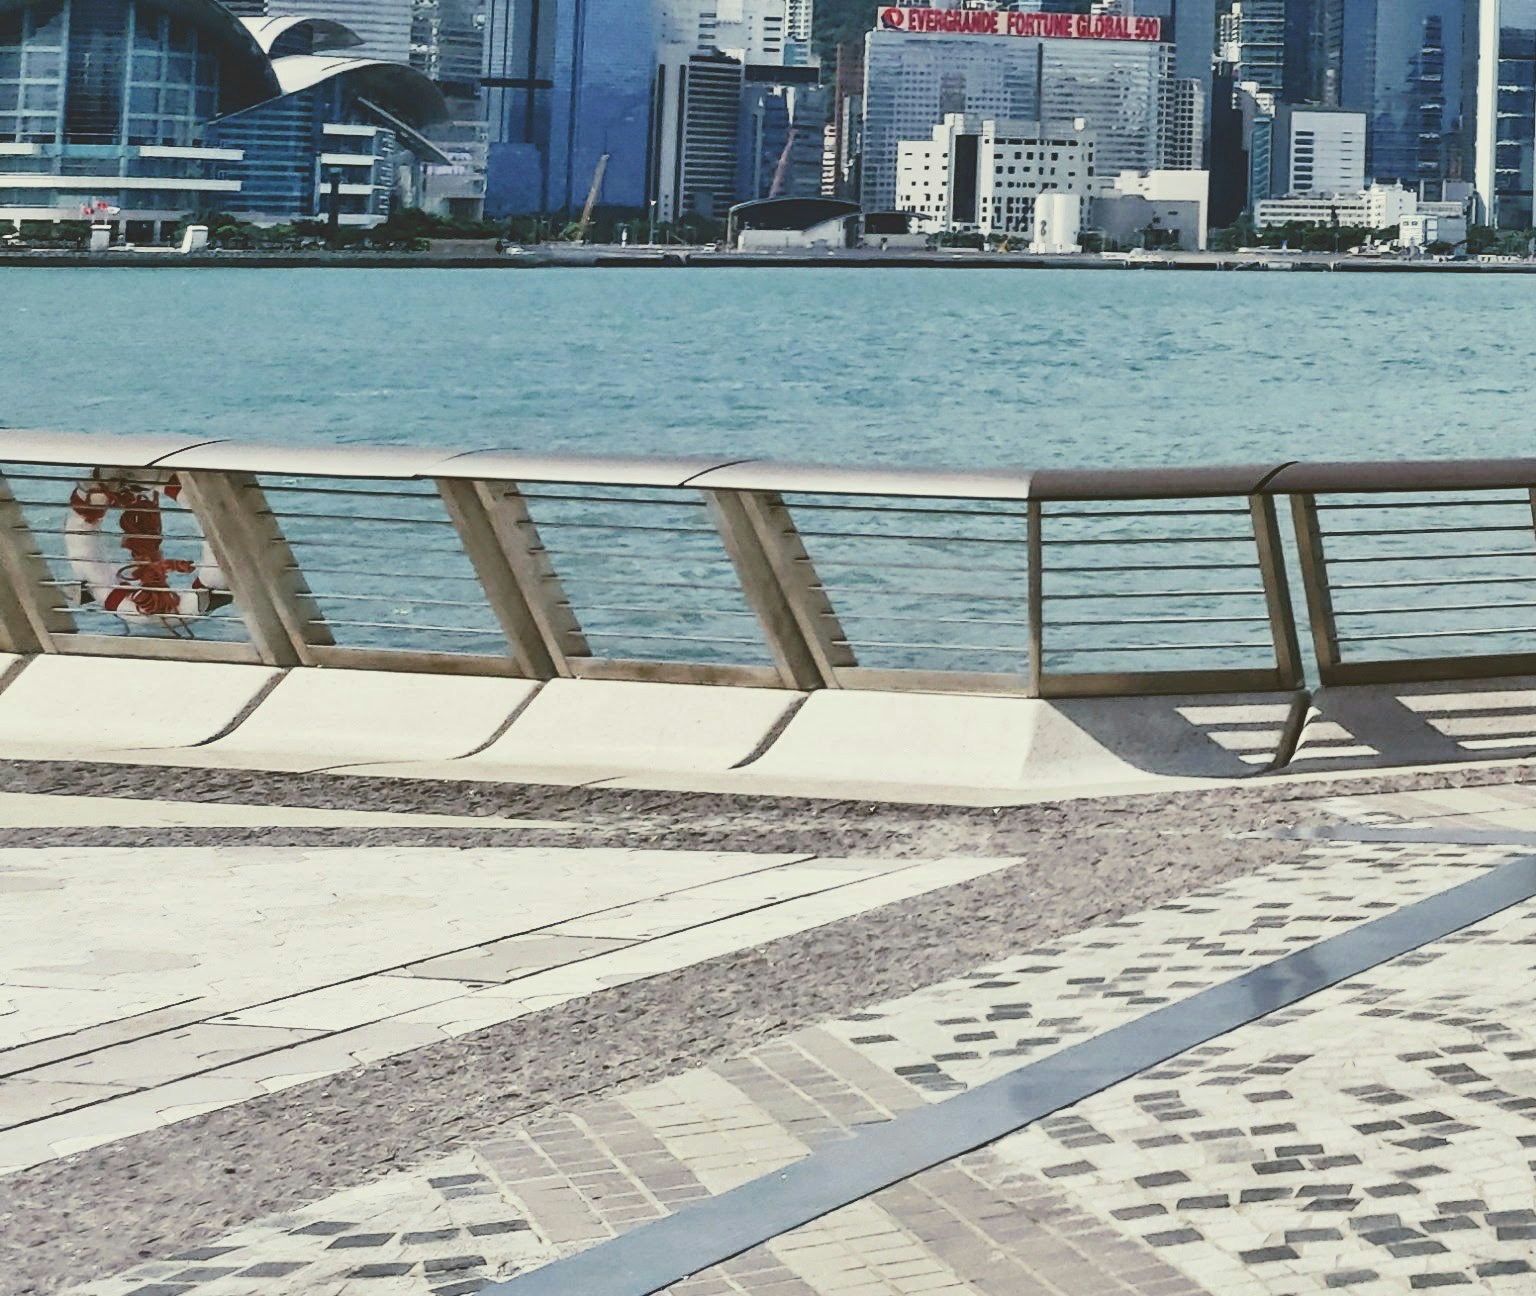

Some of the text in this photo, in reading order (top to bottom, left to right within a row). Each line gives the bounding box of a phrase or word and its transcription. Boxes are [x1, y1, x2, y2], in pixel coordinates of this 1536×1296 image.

[908, 7, 1158, 40] EVERGRANDE FORTUNE GLOBAL 500
